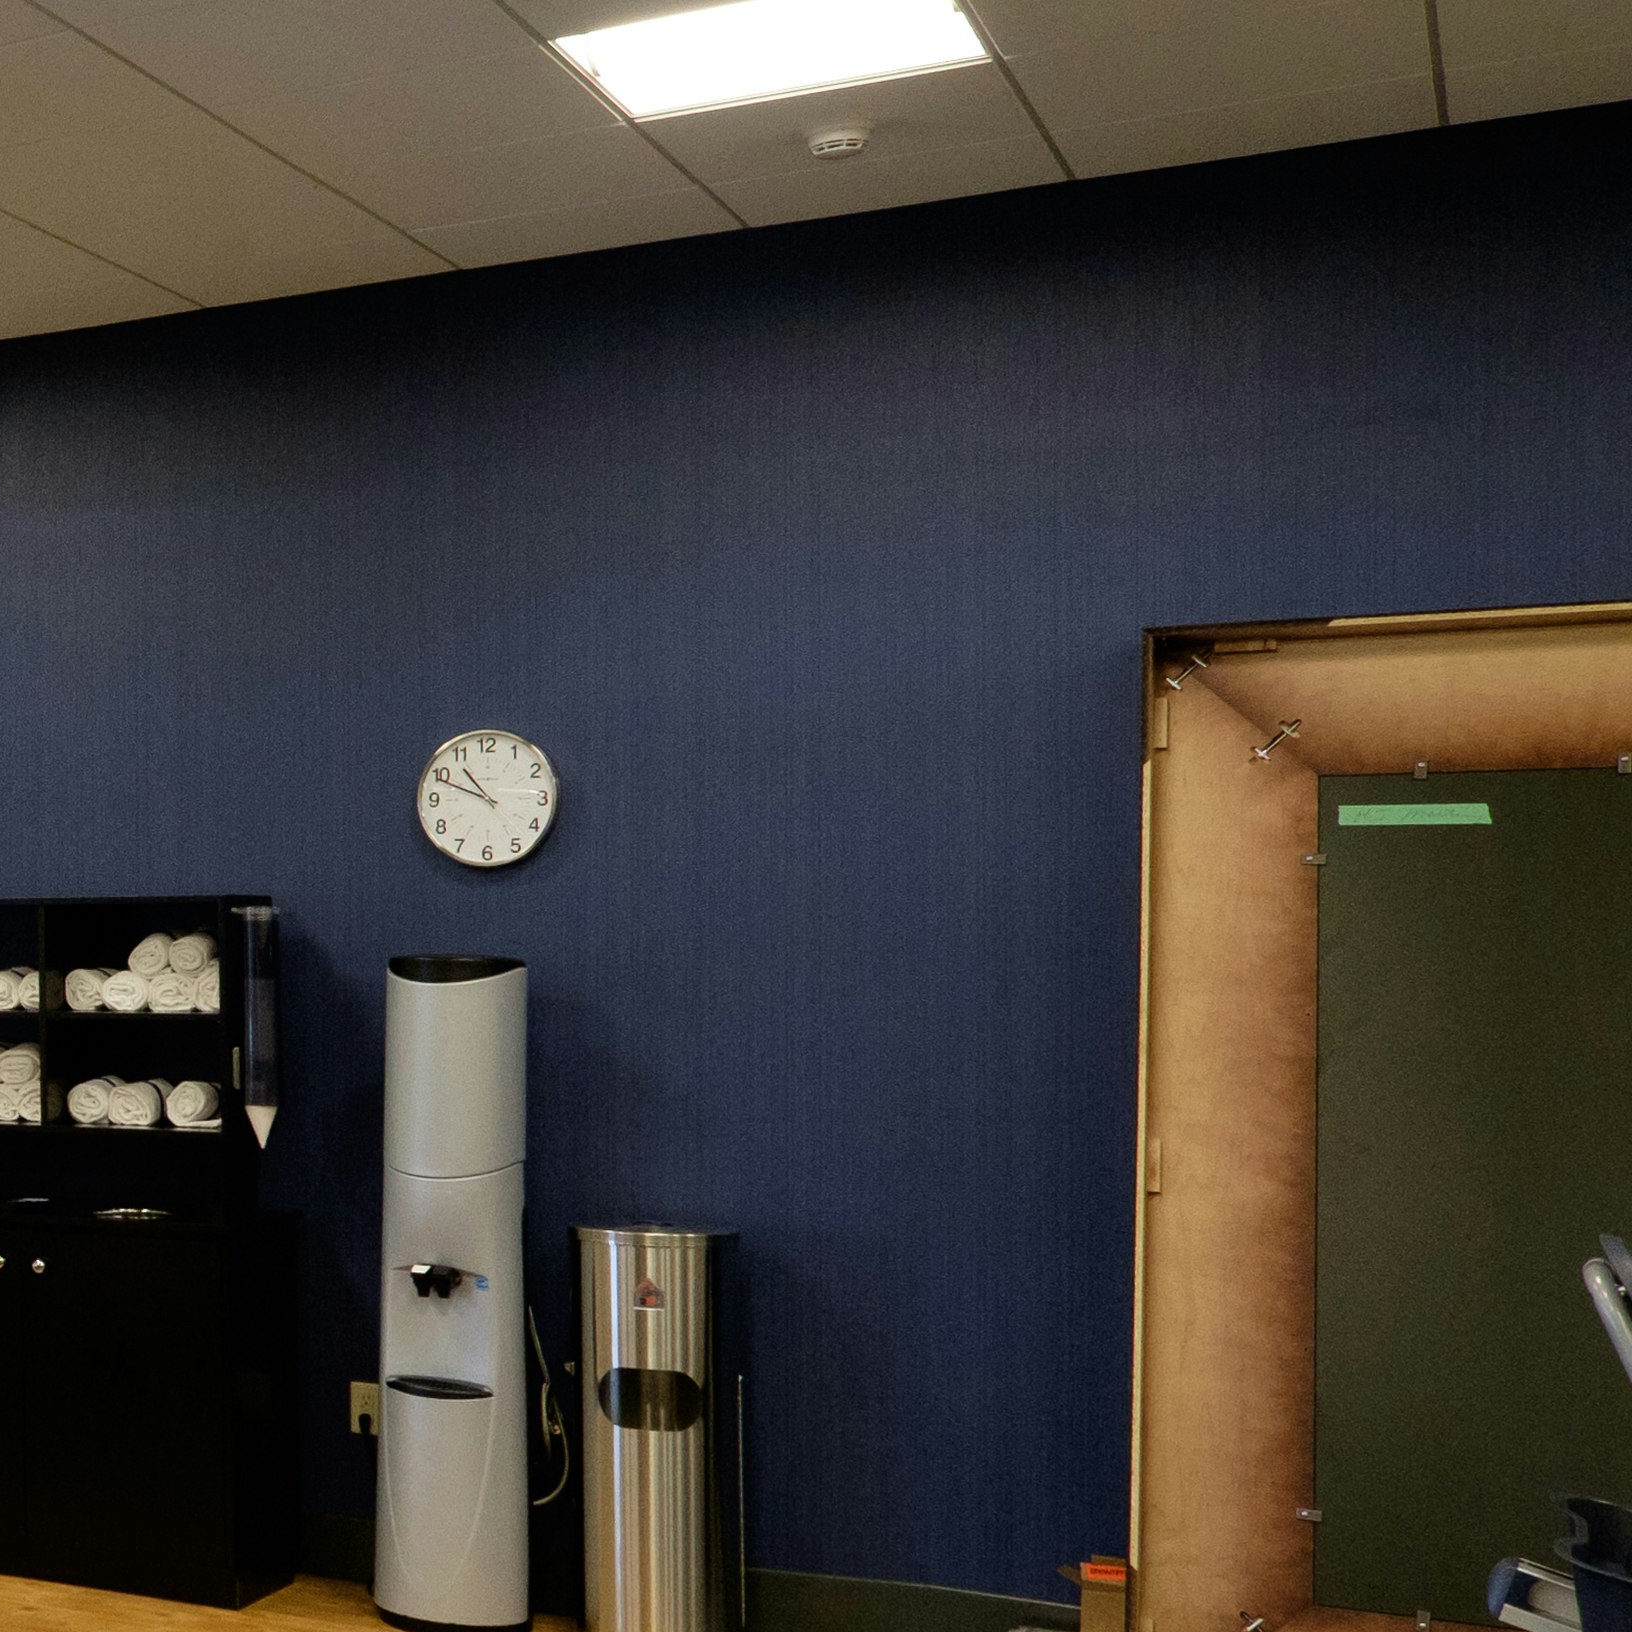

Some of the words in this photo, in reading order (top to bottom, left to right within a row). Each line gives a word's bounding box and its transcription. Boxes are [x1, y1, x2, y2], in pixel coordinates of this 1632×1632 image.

[477, 737, 496, 753] 12
[510, 744, 517, 759] 1
[452, 746, 467, 762] 11
[432, 767, 450, 783] 10
[530, 763, 541, 778] 2
[429, 792, 440, 808] 9
[537, 790, 549, 806] 3
[436, 819, 446, 834] 8
[529, 817, 540, 832] 4
[454, 838, 465, 853] 7
[482, 845, 493, 861] 6
[510, 838, 521, 853] 5
